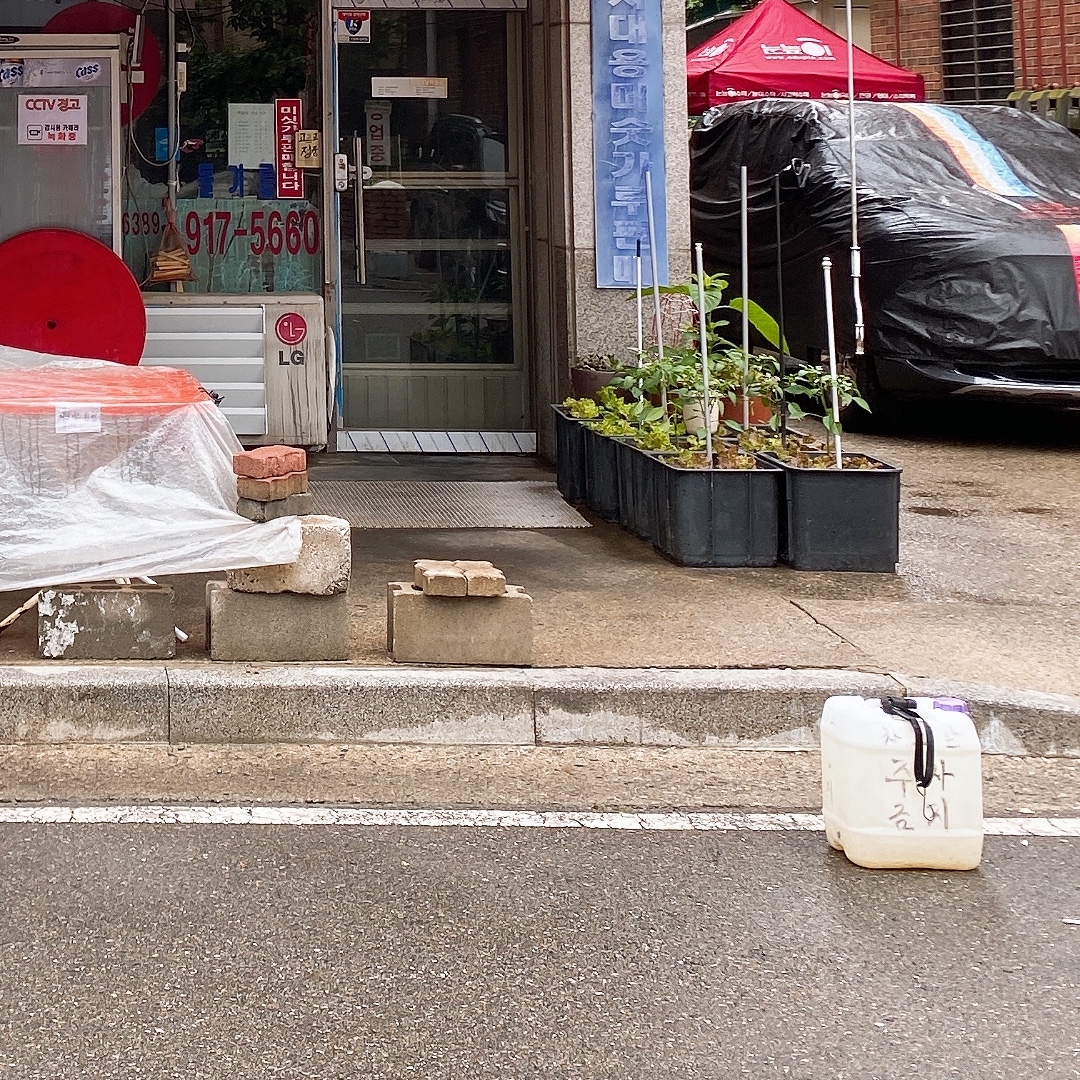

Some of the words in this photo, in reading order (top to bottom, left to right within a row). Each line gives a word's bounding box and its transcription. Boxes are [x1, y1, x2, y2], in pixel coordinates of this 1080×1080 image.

[75, 63, 100, 79] Cass
[25, 98, 57, 111] CCTV
[57, 97, 81, 112] 경고
[62, 124, 80, 132] 카메라
[185, 210, 320, 256] 917-5660
[278, 350, 305, 366] LG
